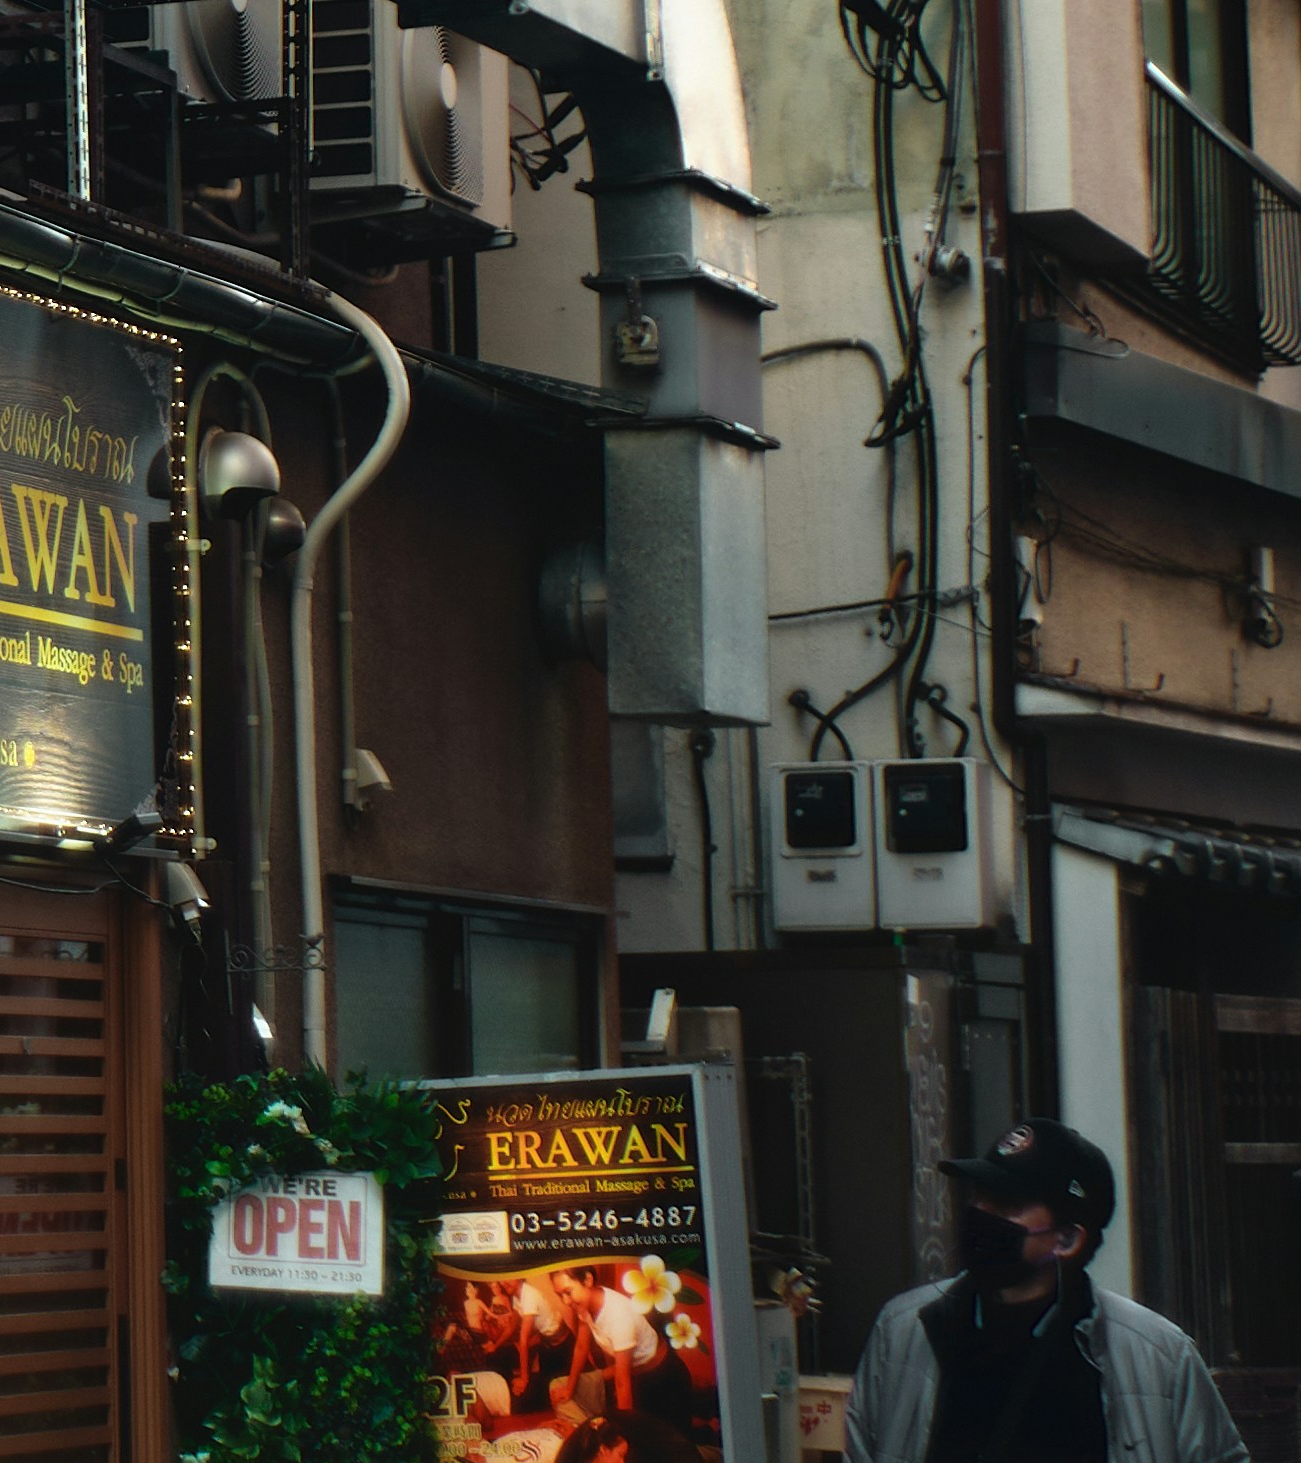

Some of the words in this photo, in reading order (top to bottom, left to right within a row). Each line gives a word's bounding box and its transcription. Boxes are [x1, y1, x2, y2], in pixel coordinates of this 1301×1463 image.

[37, 637, 96, 686] Massage
[101, 649, 113, 681] &
[120, 657, 143, 694] Spa
[486, 1123, 687, 1170] ERAWAN
[260, 1175, 337, 1197] WE'RE
[490, 1184, 517, 1198] Thai
[523, 1180, 590, 1197] Traditional
[596, 1179, 649, 1196] Massage
[655, 1177, 665, 1190] &
[672, 1177, 695, 1192] Spa
[233, 1193, 361, 1261] OPEN
[511, 1206, 696, 1234] 03-5246-4887
[513, 1232, 701, 1251] www.erawan-asakusa.com
[231, 1265, 283, 1278] EVERYDAY
